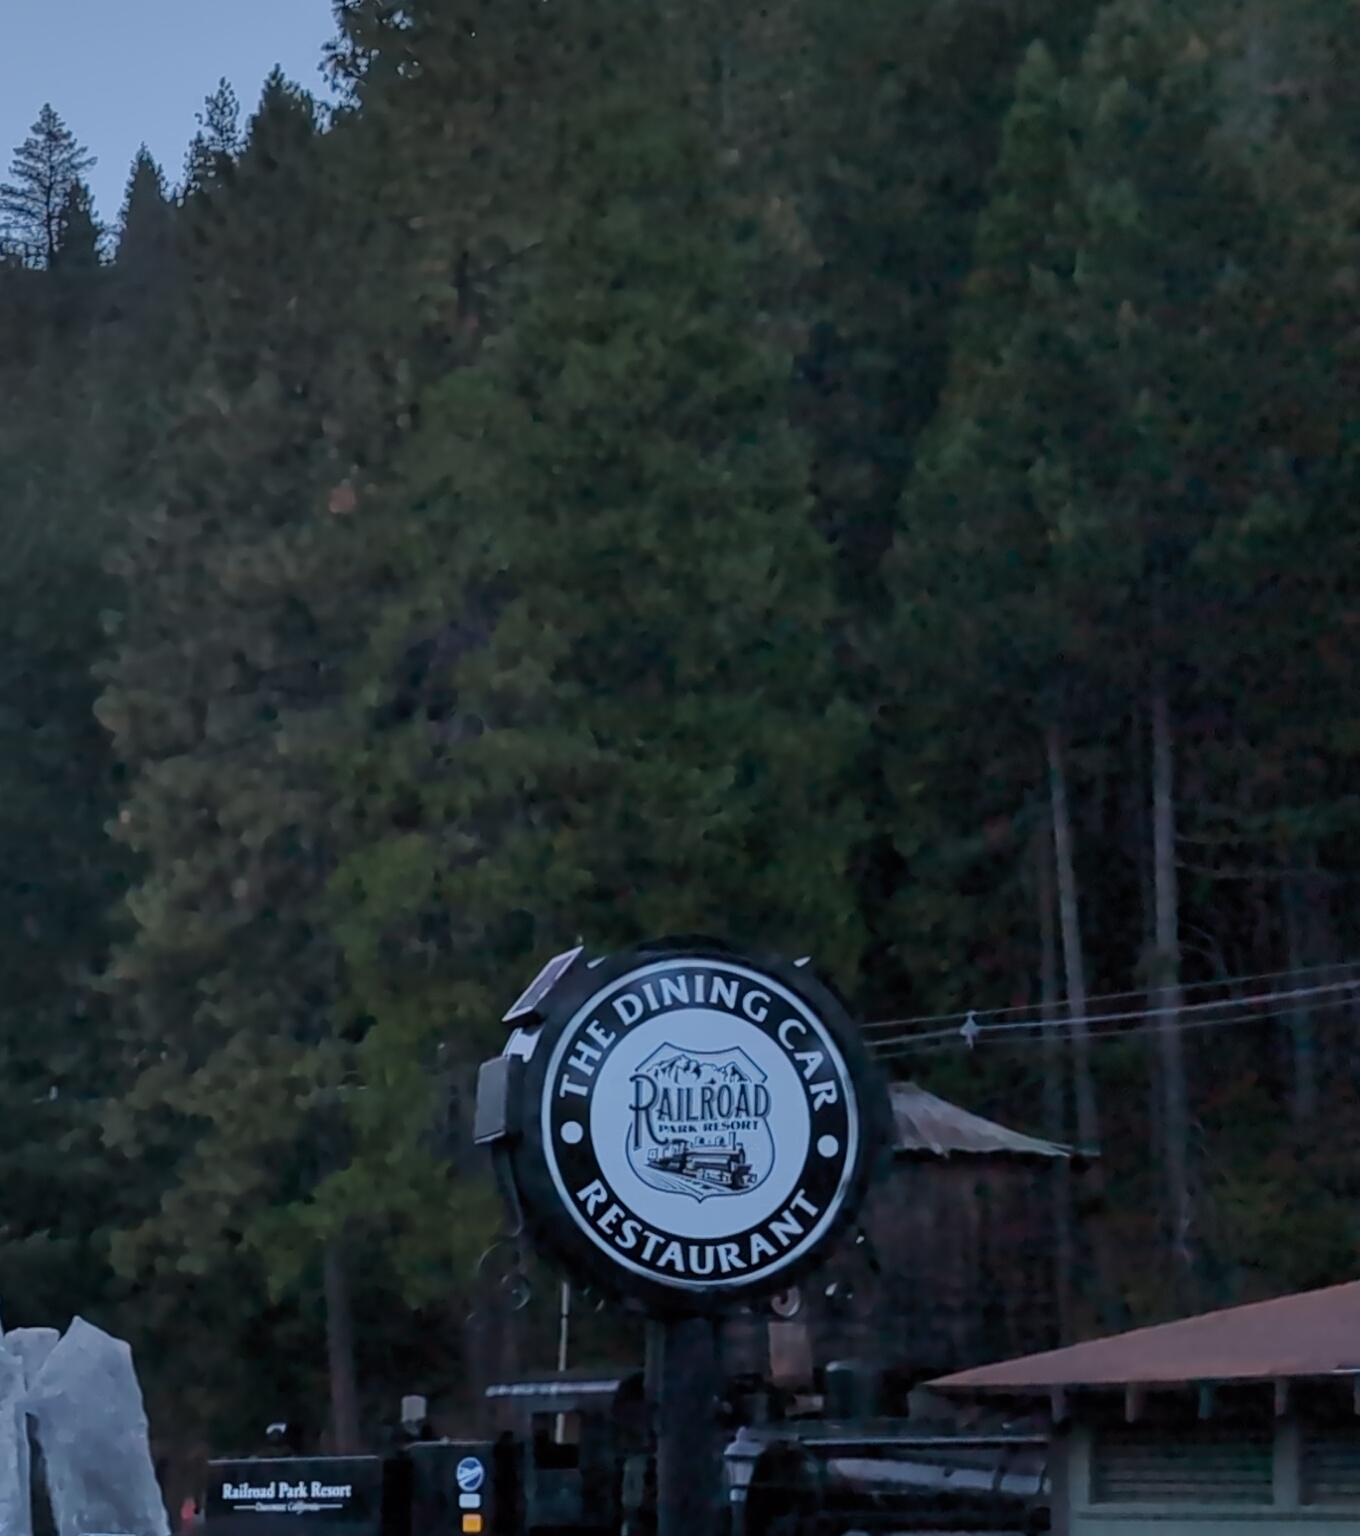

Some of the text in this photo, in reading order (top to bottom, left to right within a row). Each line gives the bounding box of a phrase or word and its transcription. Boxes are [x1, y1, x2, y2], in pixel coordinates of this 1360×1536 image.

[560, 975, 838, 1110] THE DINING CAR
[628, 1074, 771, 1151] RAILROAD
[658, 1120, 759, 1133] PARK RESORT
[577, 1179, 820, 1275] RESTAURANT
[222, 1481, 352, 1499] Railroad Park Resort
